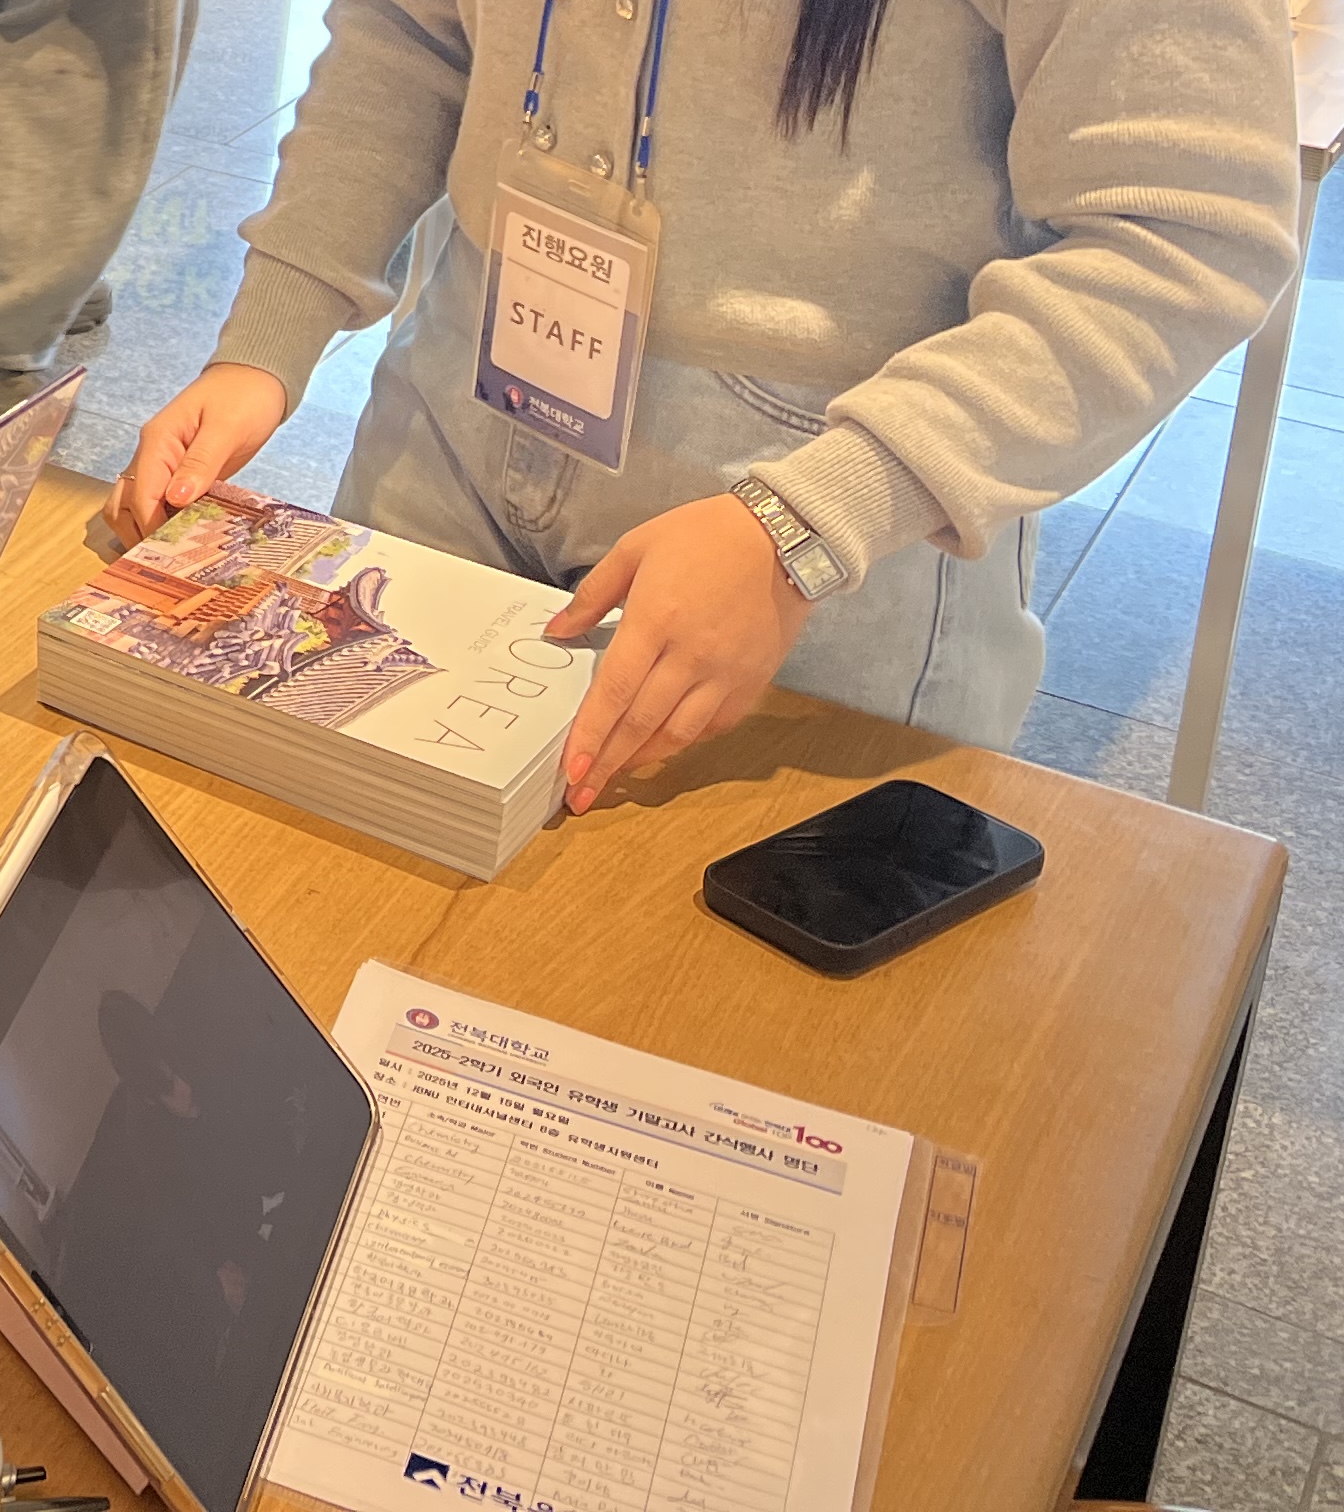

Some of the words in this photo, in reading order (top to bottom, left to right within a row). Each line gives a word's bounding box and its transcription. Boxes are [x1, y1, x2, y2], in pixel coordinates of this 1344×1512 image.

[521, 223, 613, 285] 진행요원
[510, 300, 603, 360] STAFF
[528, 395, 585, 434] 전북대학교
[491, 600, 527, 627] TRAVEL
[468, 630, 500, 655] GUIDE
[450, 1020, 550, 1062] 전북대학교
[378, 1057, 403, 1072] 일시
[417, 1070, 459, 1090] 2025년
[466, 1086, 492, 1101] 12월
[499, 1097, 525, 1112] 15일
[532, 1107, 570, 1127] 월요일
[412, 1084, 440, 1100] JBNU
[412, 1040, 503, 1078] 2025-2학기
[509, 1071, 561, 1096] 외국인
[567, 1089, 619, 1113] 유학생
[625, 1107, 696, 1137] 기말고사
[704, 1130, 774, 1162] 간식행사
[783, 1154, 820, 1176] 명단
[792, 1125, 843, 1155] 100
